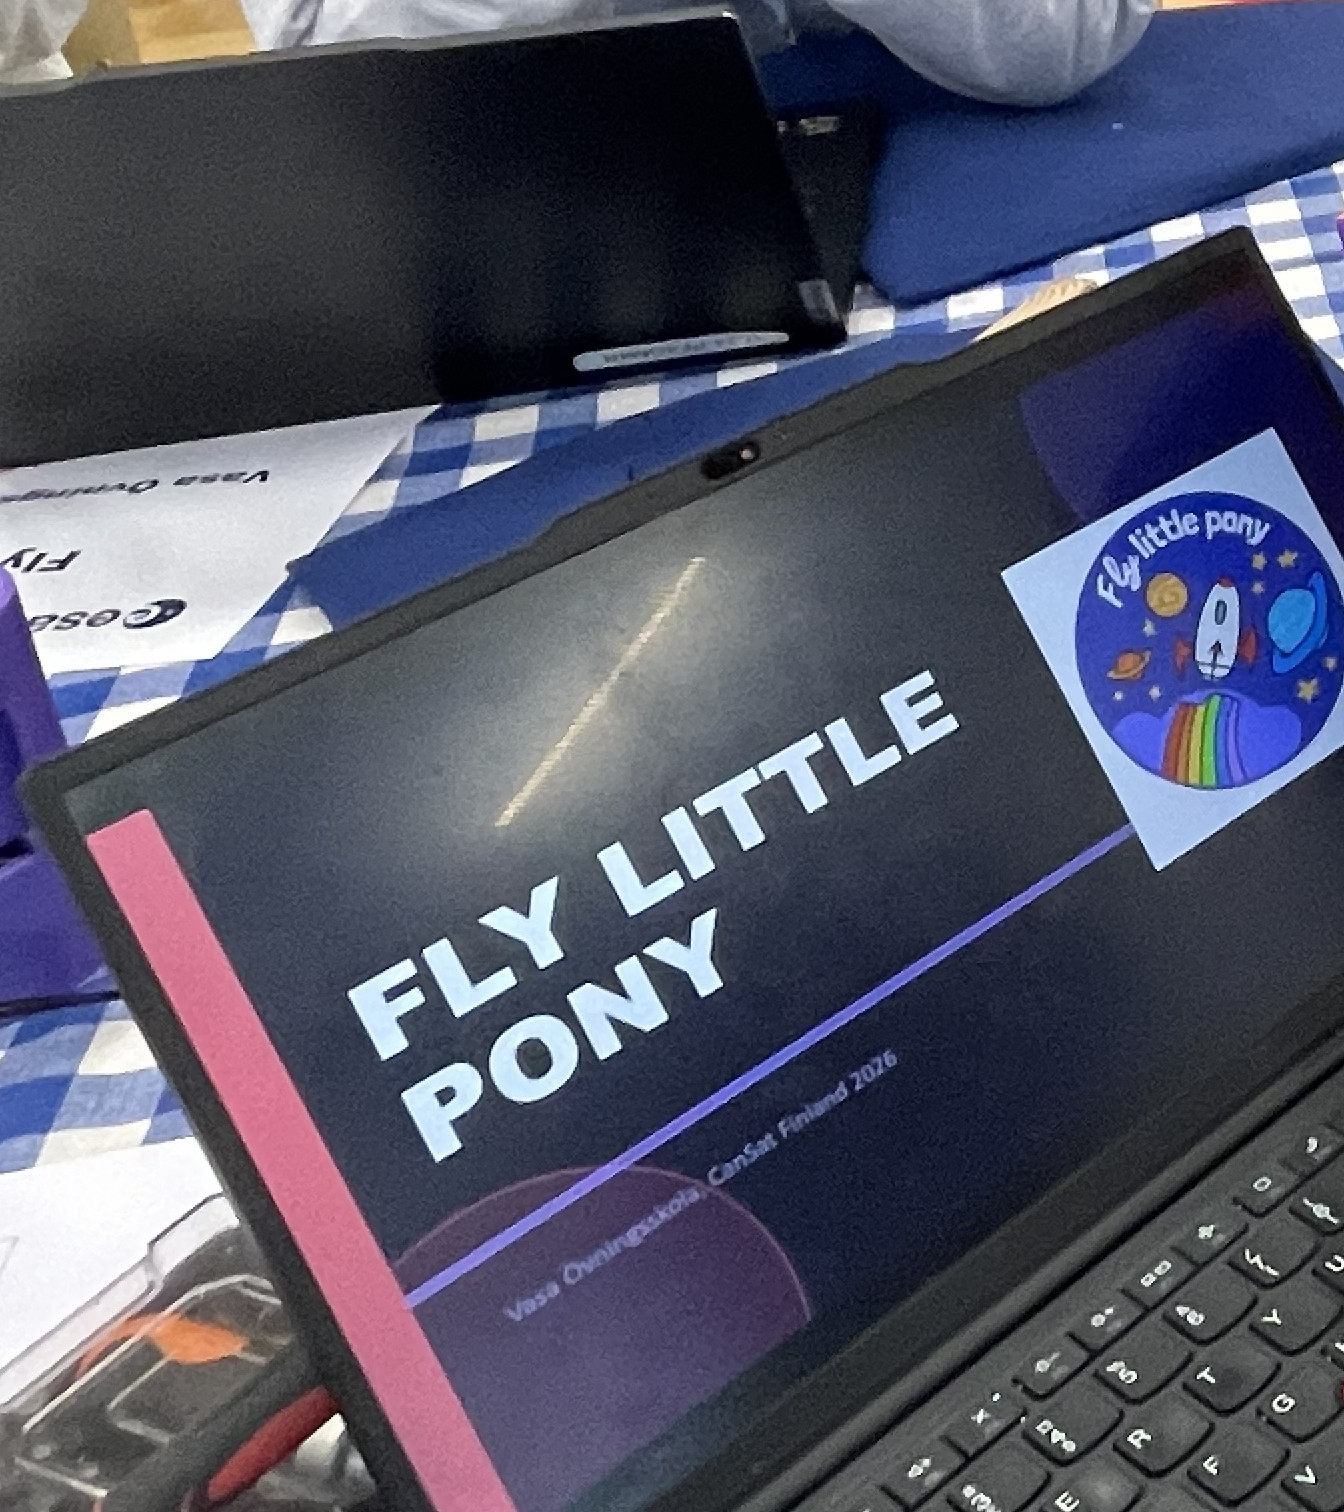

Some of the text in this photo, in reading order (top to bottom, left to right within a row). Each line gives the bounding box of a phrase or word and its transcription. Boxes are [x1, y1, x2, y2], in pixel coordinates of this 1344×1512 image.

[0, 547, 82, 573] Fly
[1096, 508, 1271, 609] Fly little pony
[347, 669, 960, 1062] FLY LITTLE
[400, 908, 724, 1164] PONY
[506, 1282, 561, 1322] Vasa
[707, 1132, 779, 1187] CanSat
[777, 1081, 849, 1140] Finland
[849, 1048, 899, 1091] 2026
[1126, 1428, 1152, 1450] R
[1196, 1366, 1216, 1384] T
[1261, 1308, 1282, 1326] Y
[1202, 1454, 1219, 1476] F
[1271, 1392, 1296, 1414] G
[1294, 1464, 1317, 1485] V
